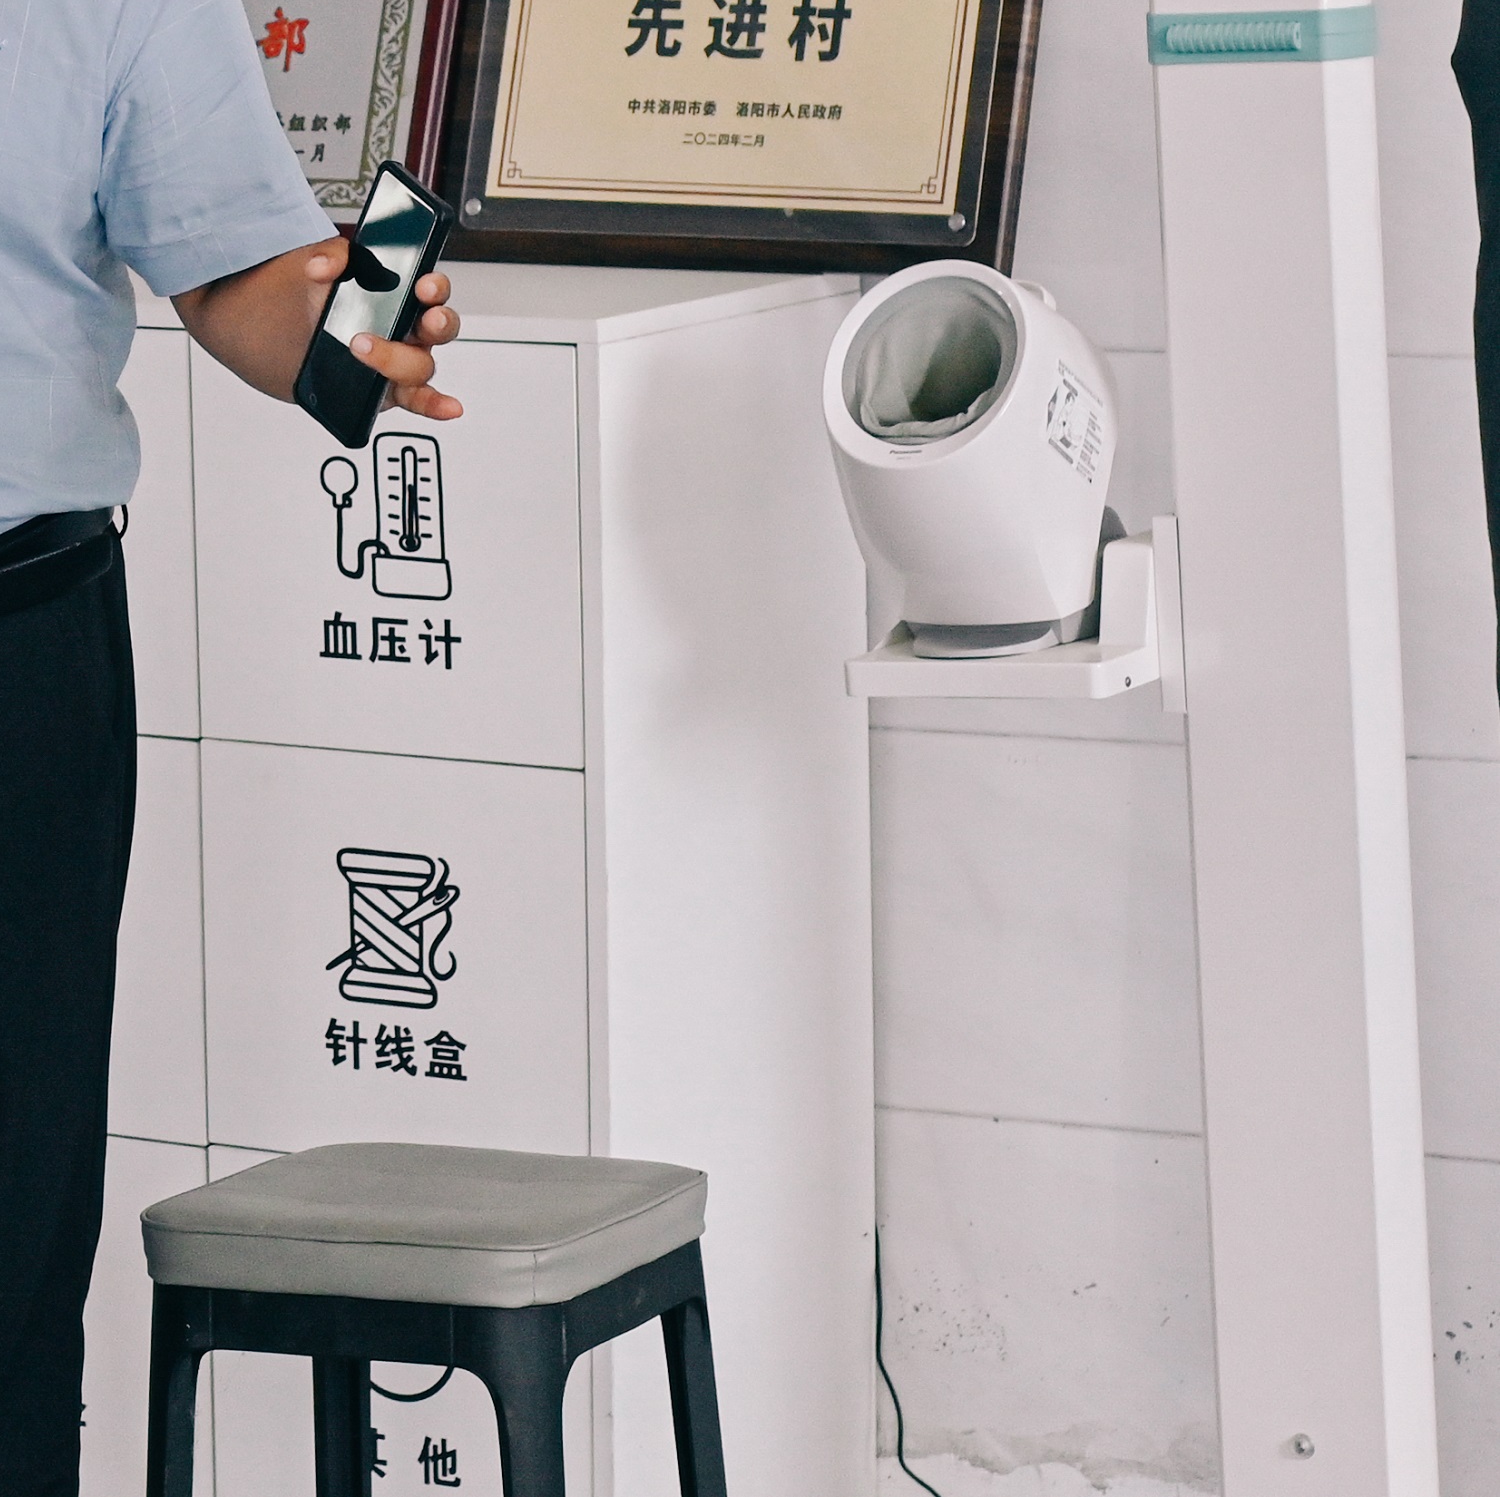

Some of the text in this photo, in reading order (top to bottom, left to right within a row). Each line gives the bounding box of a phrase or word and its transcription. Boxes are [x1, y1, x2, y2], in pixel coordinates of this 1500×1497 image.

[627, 99, 843, 121] 中共洛阳市委 洛阳市人民政府
[319, 611, 462, 669] 血压计
[325, 1018, 468, 1082] 针线盒
